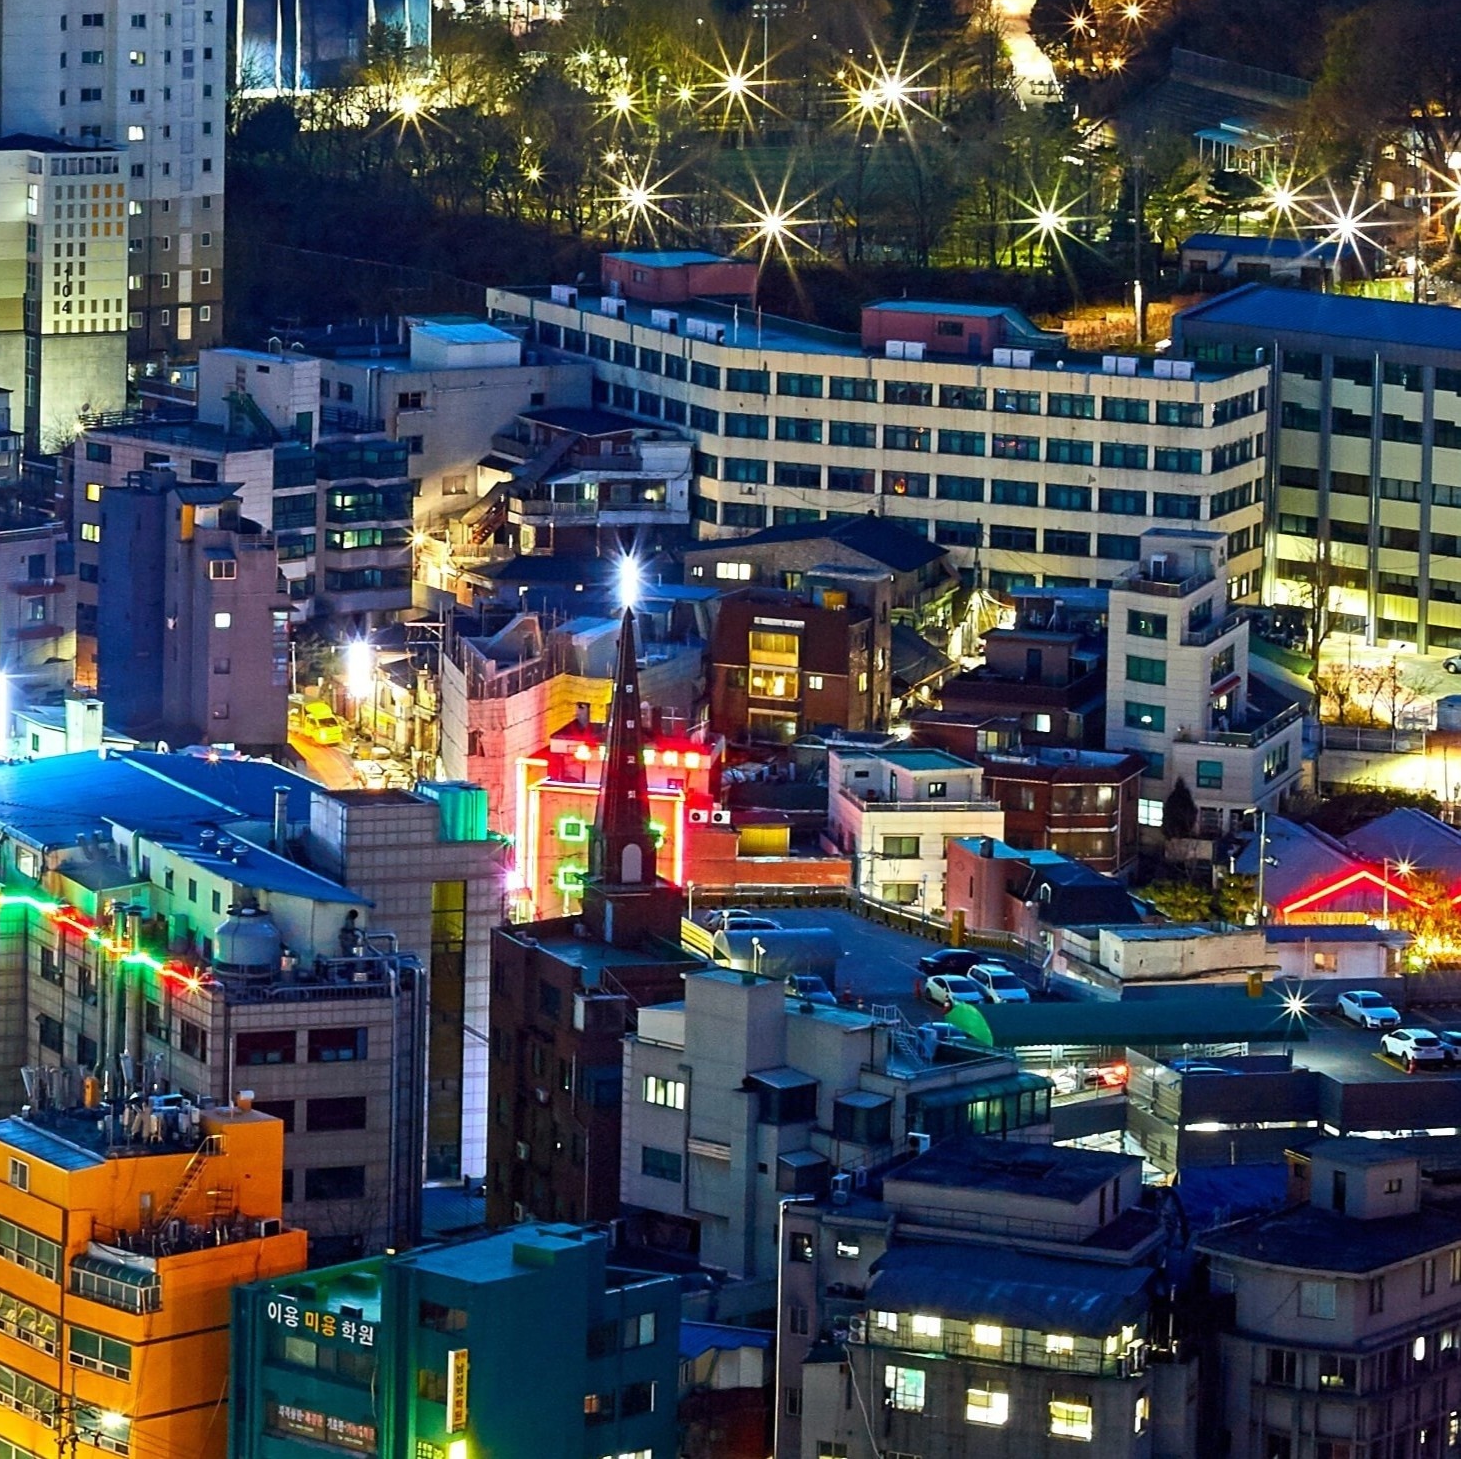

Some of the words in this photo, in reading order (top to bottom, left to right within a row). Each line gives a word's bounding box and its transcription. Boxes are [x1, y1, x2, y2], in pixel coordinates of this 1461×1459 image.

[62, 269, 72, 314] 104
[267, 1302, 299, 1327] 이용
[305, 1311, 336, 1336] 미용
[341, 1321, 374, 1346] 학원
